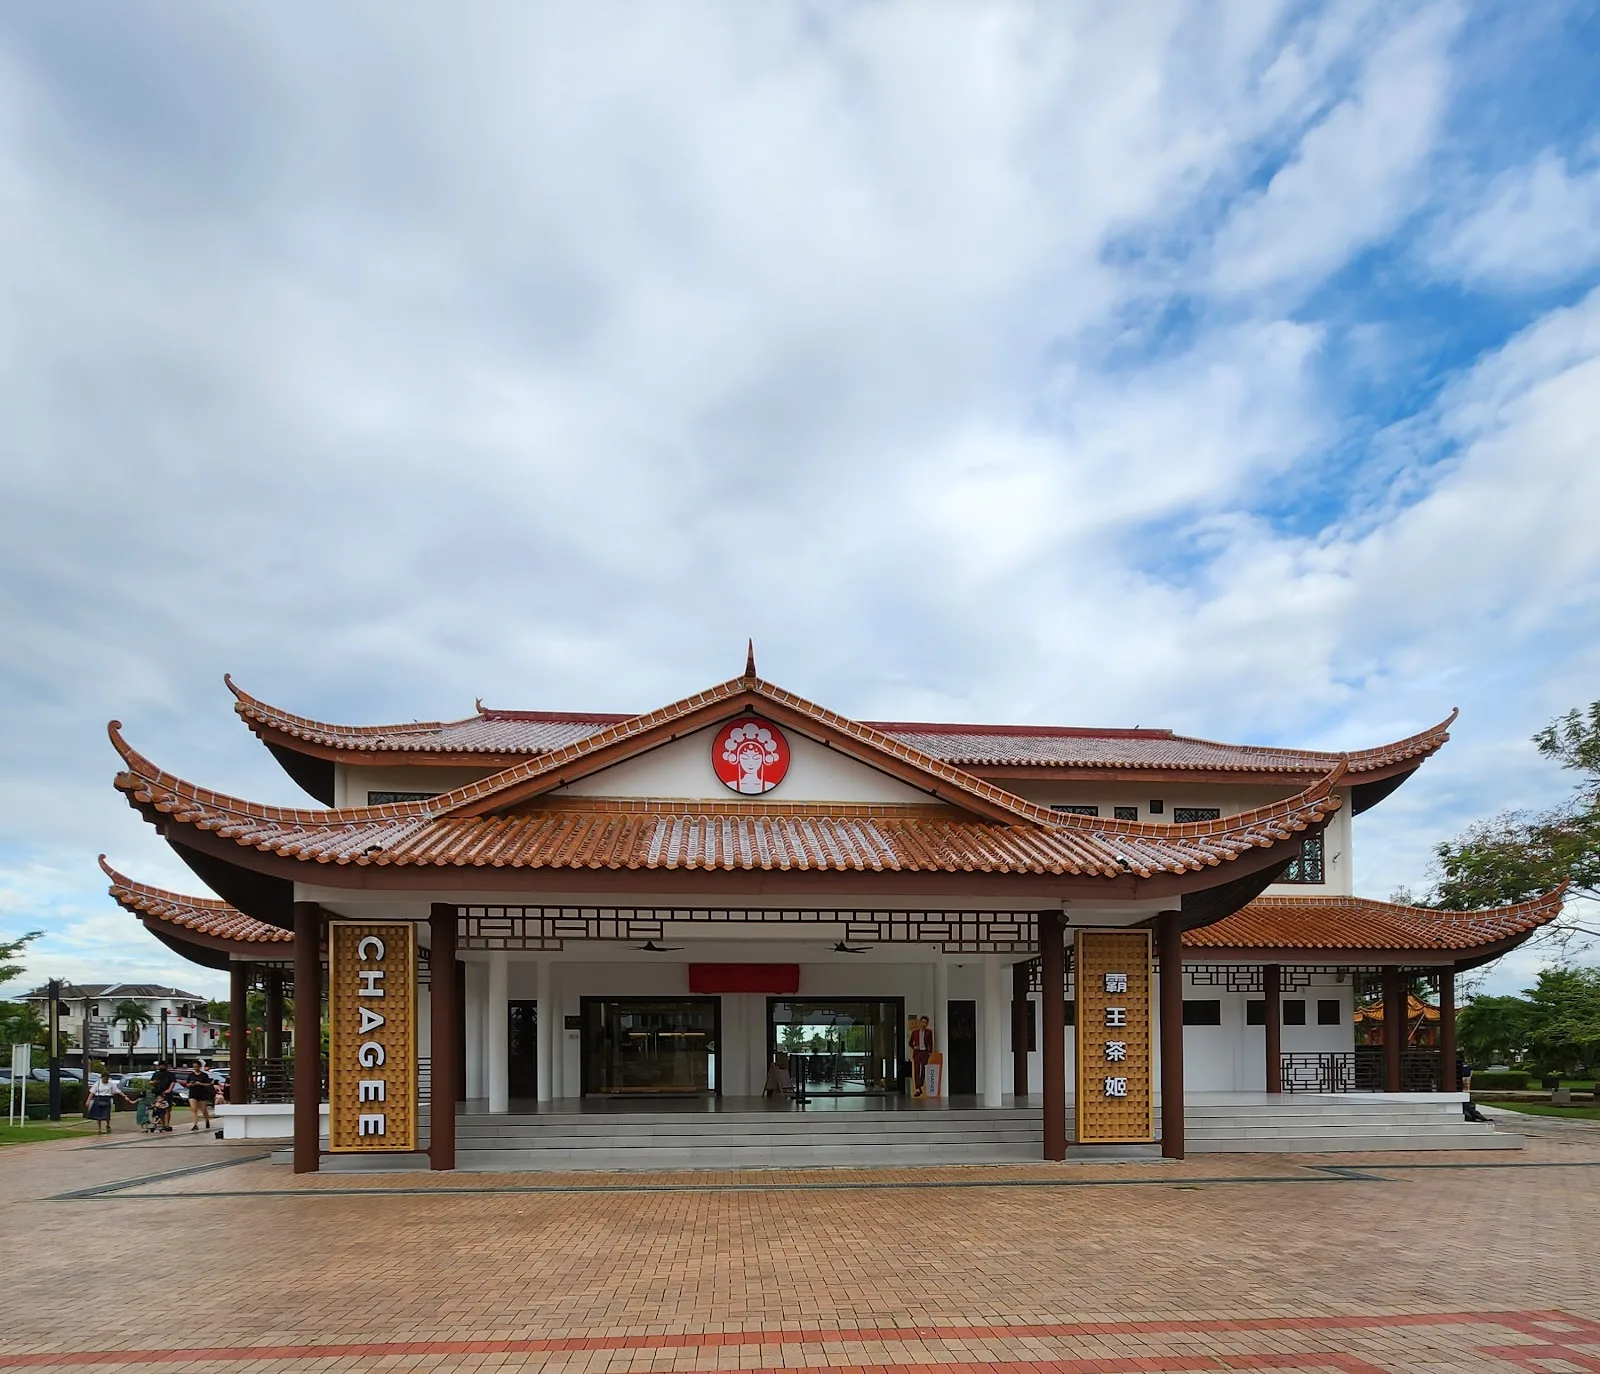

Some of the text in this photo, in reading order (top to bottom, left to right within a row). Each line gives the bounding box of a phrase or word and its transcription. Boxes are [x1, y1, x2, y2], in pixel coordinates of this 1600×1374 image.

[358, 935, 385, 1136] CHAGEE
[1104, 973, 1128, 1097] 霸王茶姬
